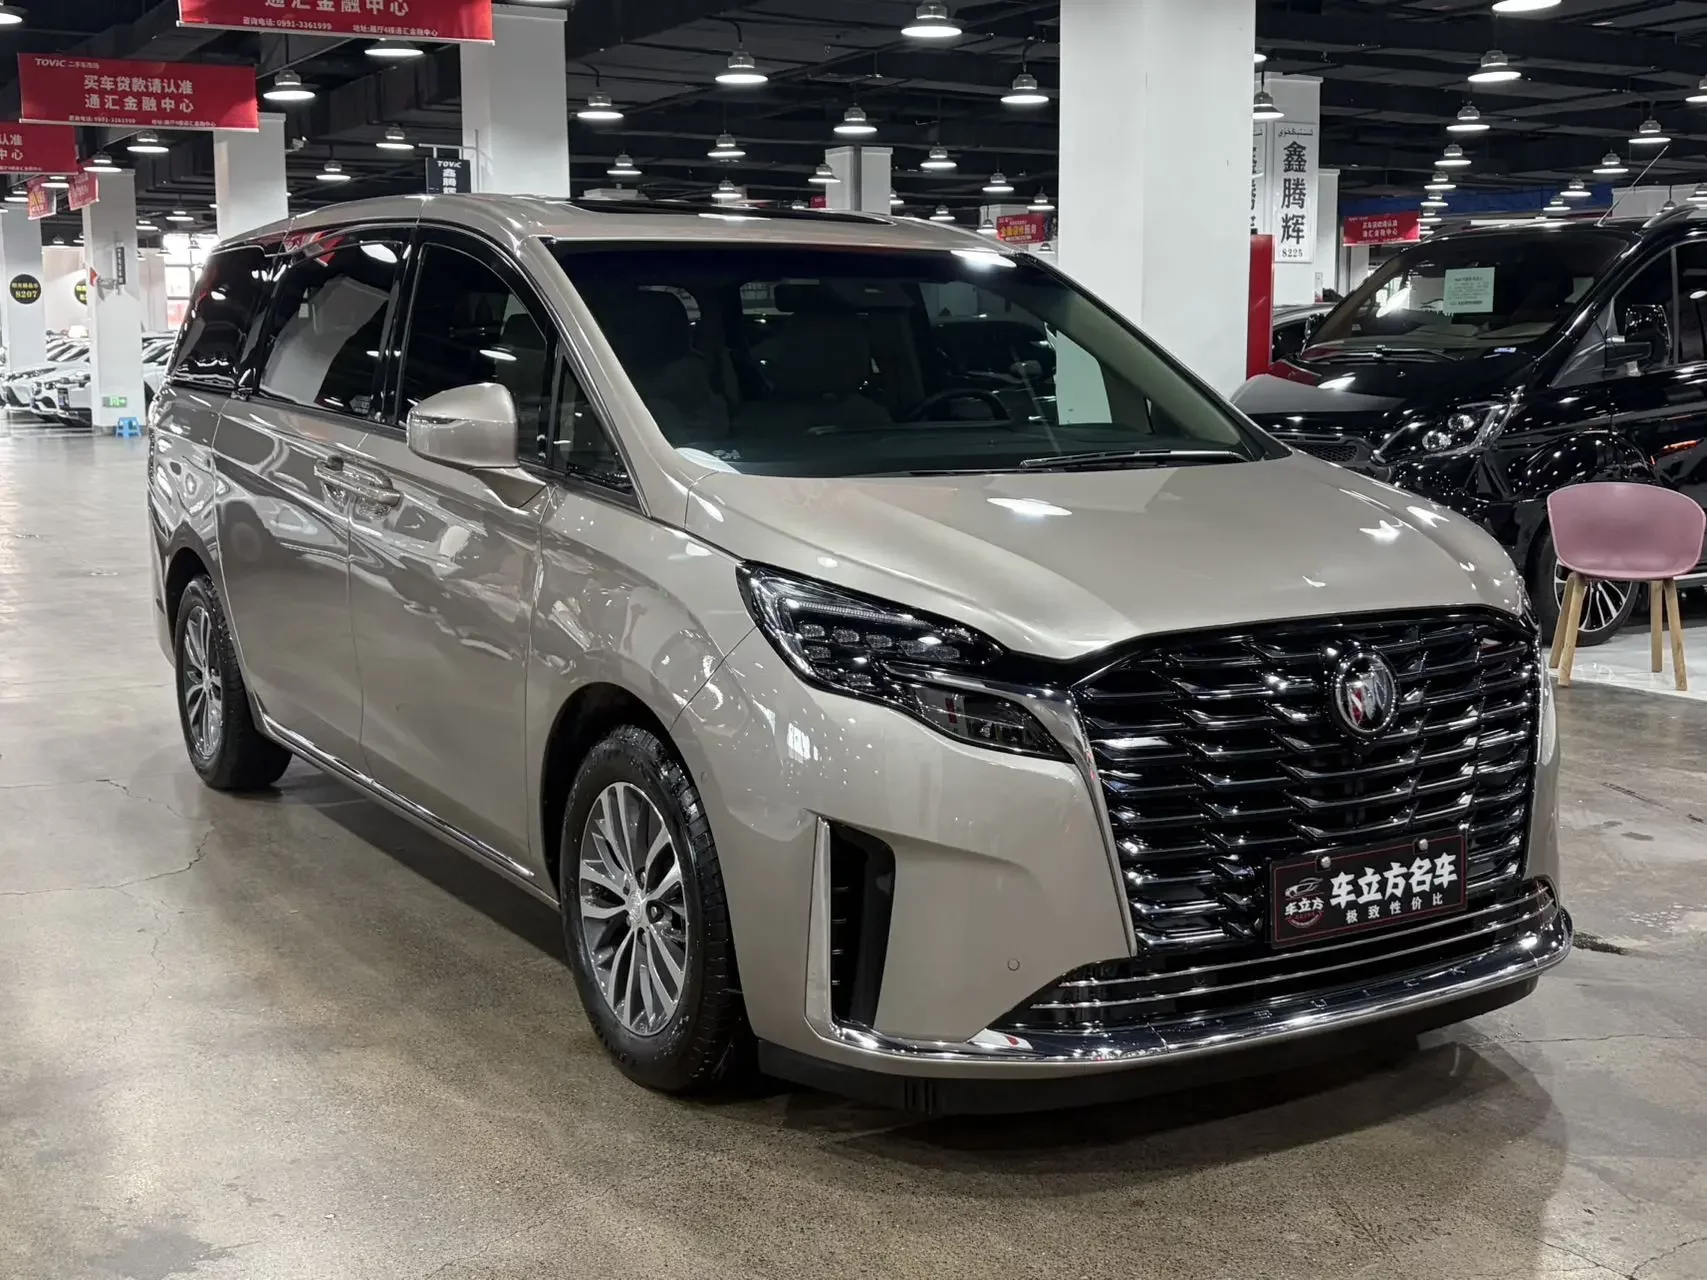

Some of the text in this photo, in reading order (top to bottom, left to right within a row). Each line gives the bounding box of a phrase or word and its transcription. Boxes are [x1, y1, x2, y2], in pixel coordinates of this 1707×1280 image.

[84, 74, 193, 95] 买车贷款请认准
[84, 94, 194, 114] 通汇金融中心
[1281, 140, 1307, 245] 鑫腾辉
[1281, 248, 1304, 258] 8225
[1329, 851, 1458, 910] 车立方名车
[1284, 896, 1324, 917] 车立方
[1345, 892, 1443, 925] 极致性价比
